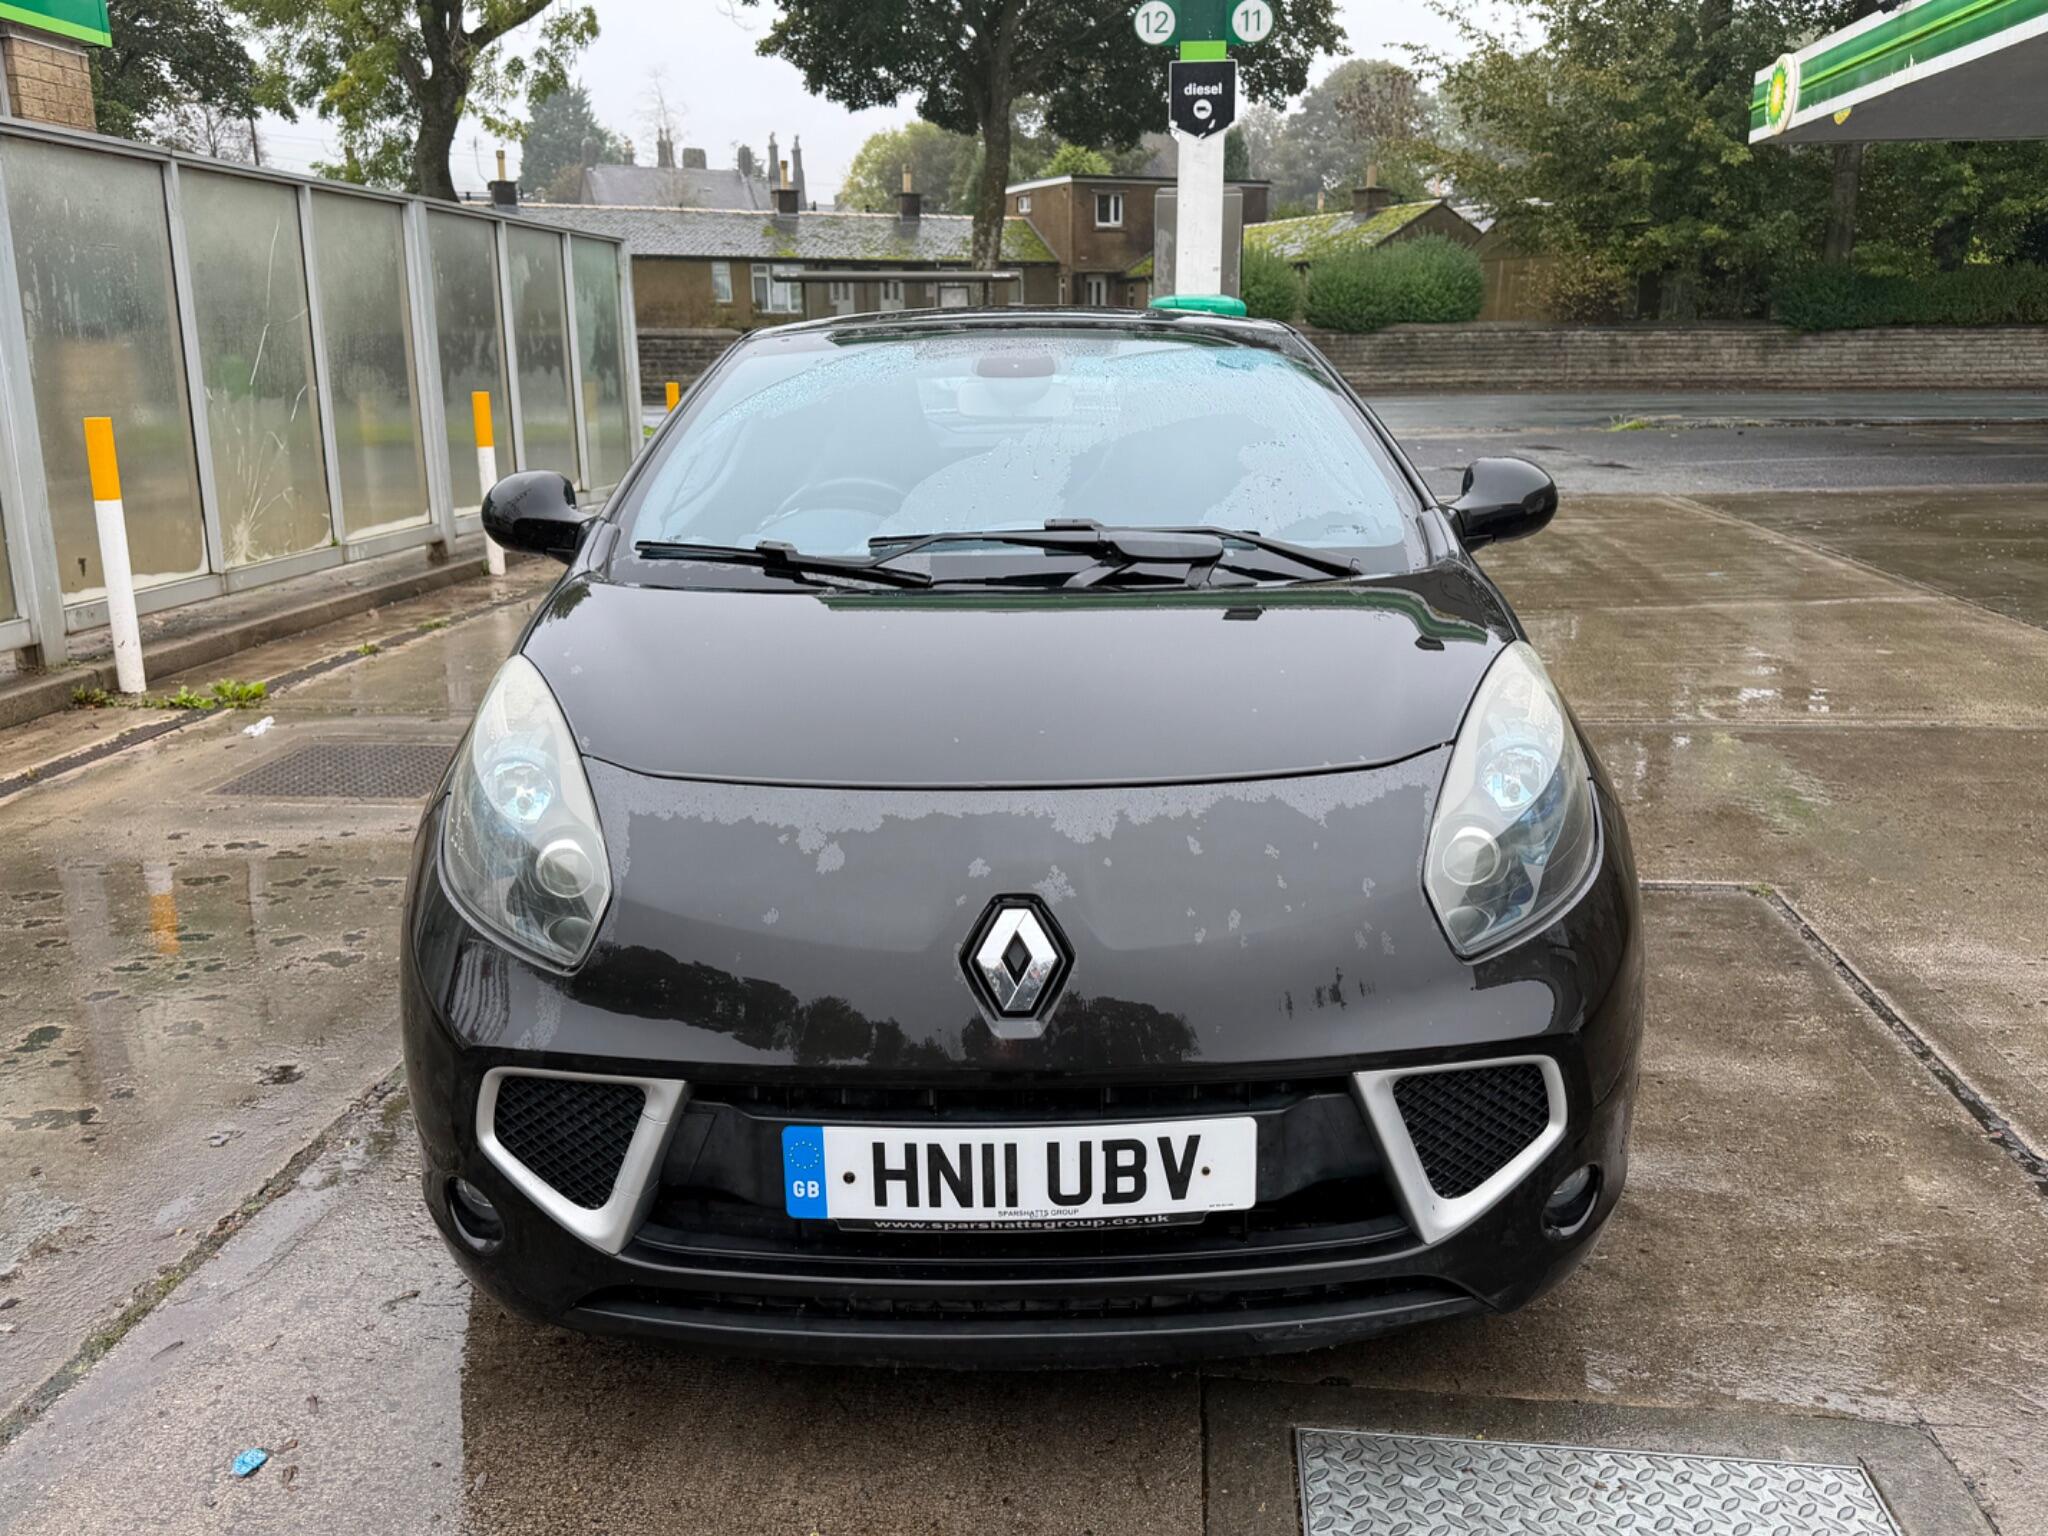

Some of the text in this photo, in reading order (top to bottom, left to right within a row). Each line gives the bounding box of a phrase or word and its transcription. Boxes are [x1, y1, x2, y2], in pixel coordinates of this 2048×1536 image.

[1142, 11, 1169, 34] 12
[1241, 9, 1261, 32] 11
[1184, 82, 1222, 95] diesel
[872, 1135, 1202, 1208] HN11 UBV
[793, 1180, 820, 1198] GB
[998, 1208, 1079, 1217] SPARSHATTS GROUP
[874, 1215, 1169, 1231] www.sparshattsgroup.co.uk
